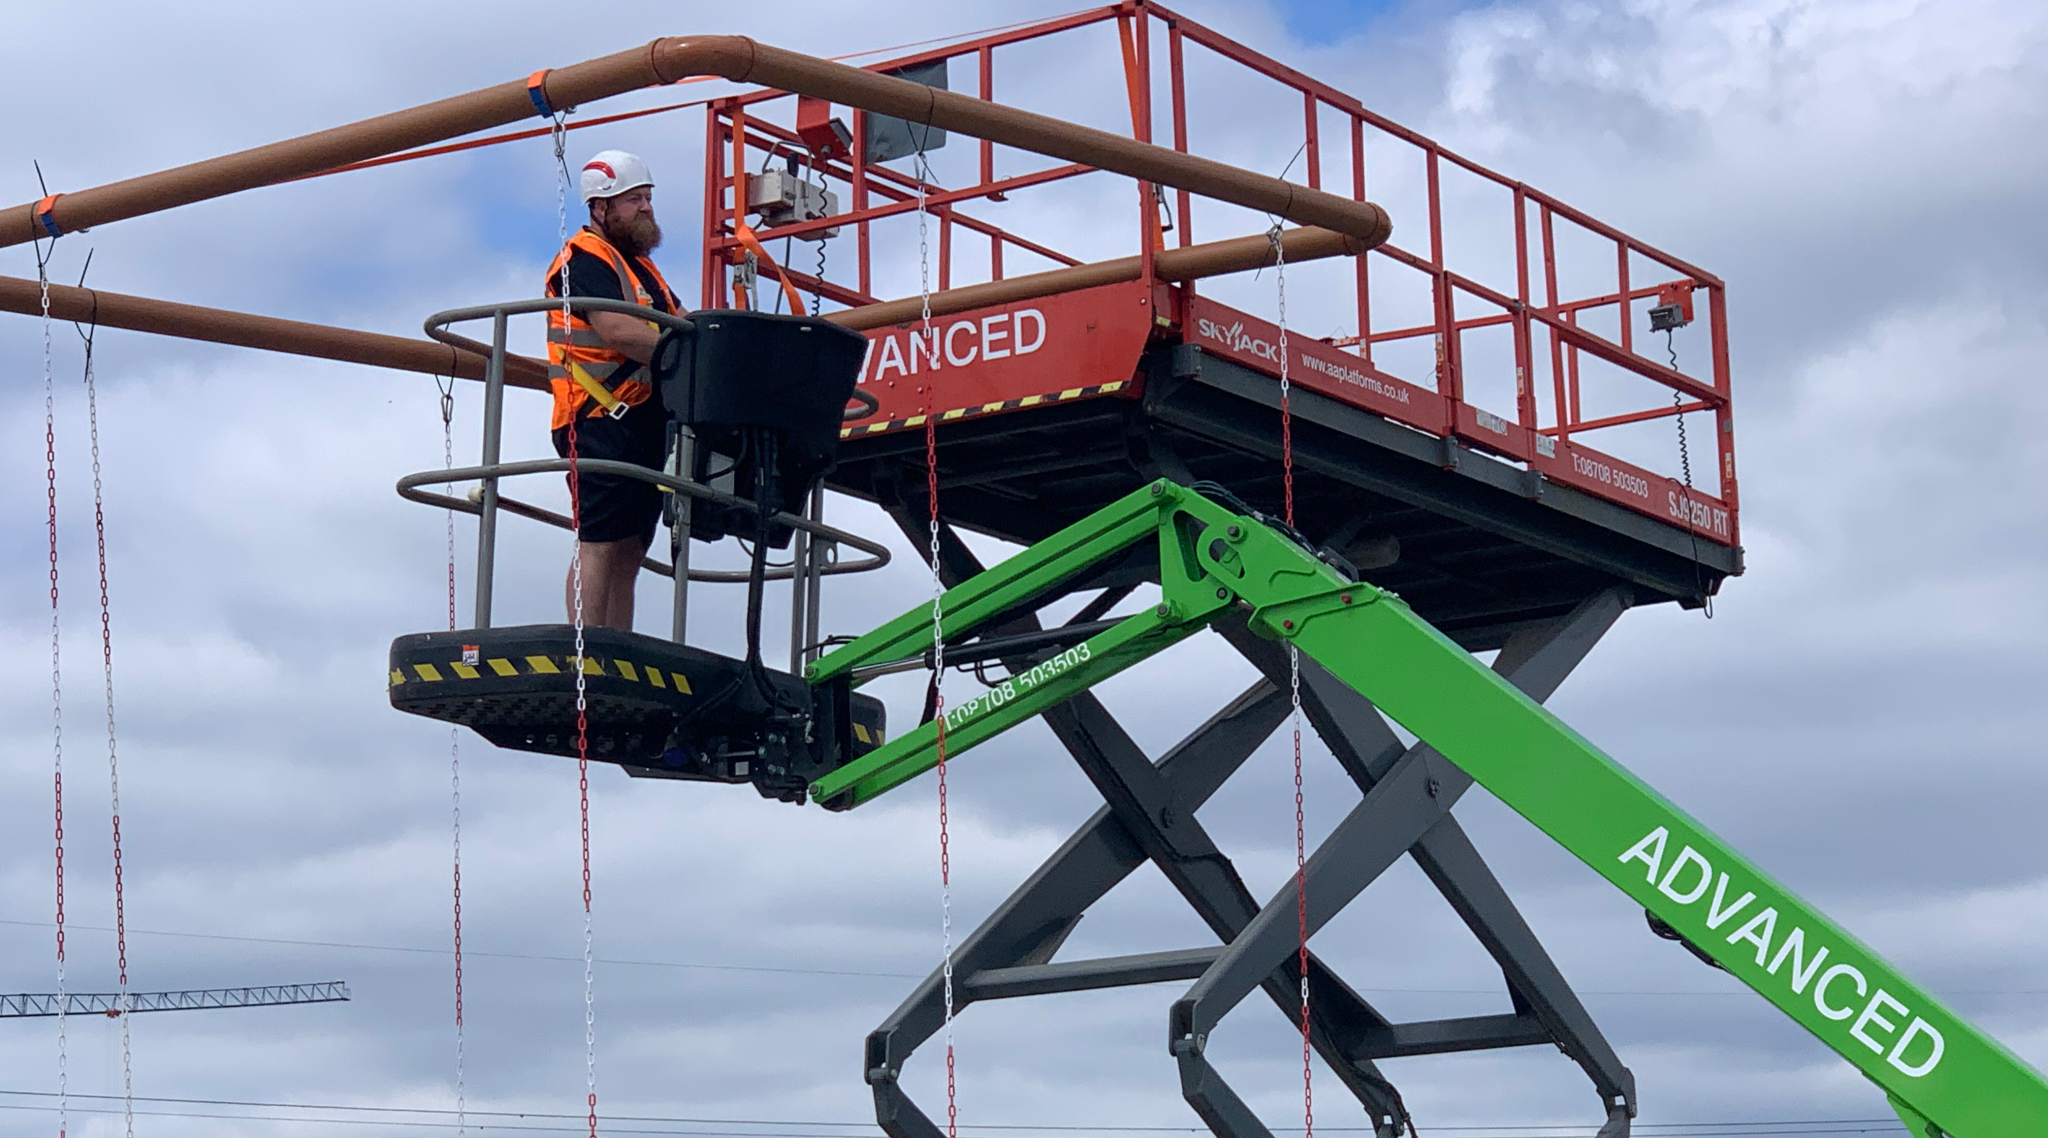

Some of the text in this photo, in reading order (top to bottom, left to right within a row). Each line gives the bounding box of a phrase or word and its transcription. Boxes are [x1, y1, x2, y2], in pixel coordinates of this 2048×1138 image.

[1198, 321, 1279, 363] SKYJACK
[1301, 352, 1410, 404] www.aaplatforms.co.uk
[1572, 453, 1648, 498] T:08708 503503
[1668, 491, 1728, 536] SJ9250 RT
[1019, 642, 1091, 687] 503503
[1617, 826, 1945, 1078] ADVANCED
